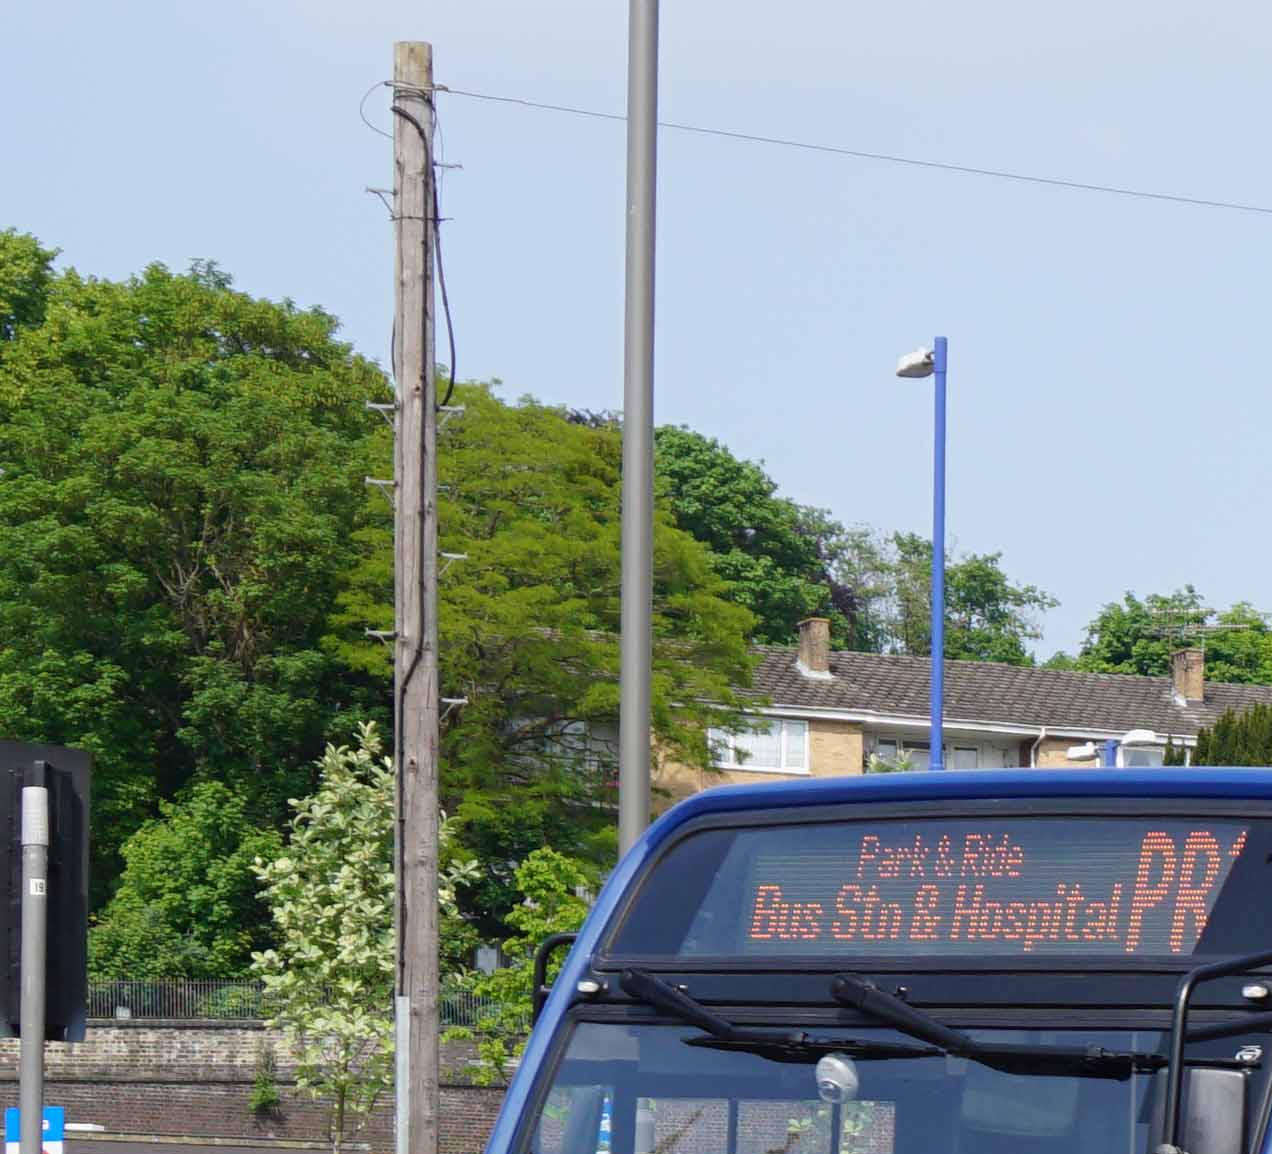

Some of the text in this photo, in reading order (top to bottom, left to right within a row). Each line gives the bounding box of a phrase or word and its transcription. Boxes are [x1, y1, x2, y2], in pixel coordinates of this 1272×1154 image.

[857, 834, 1024, 878] Park & Ride
[750, 883, 1121, 952] Bus Stn & Hospital
